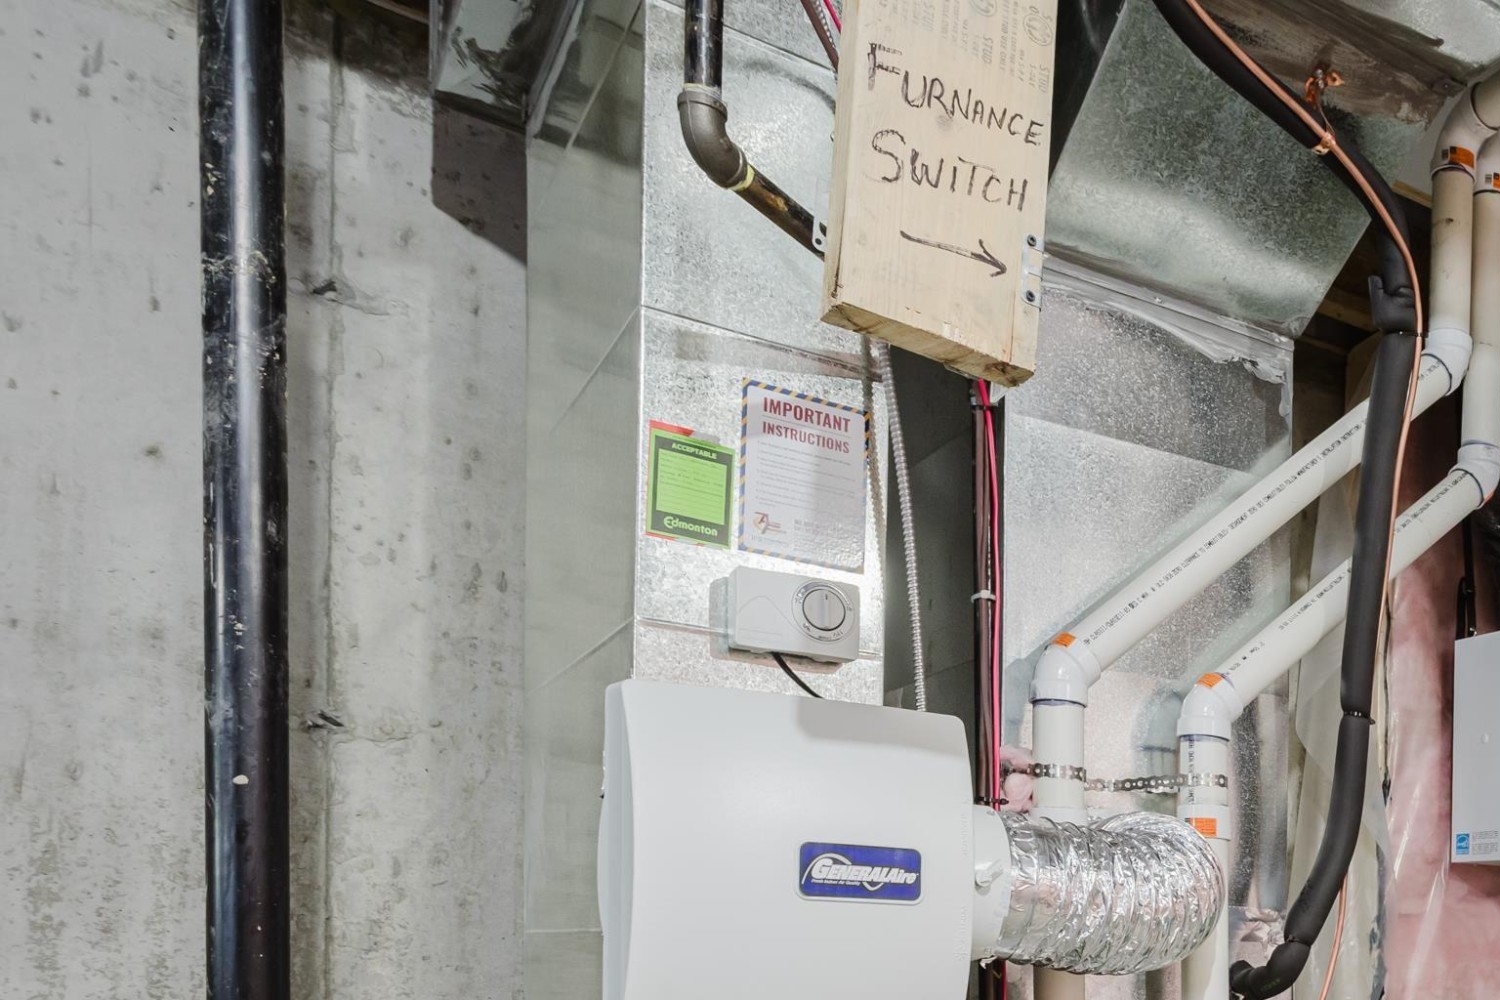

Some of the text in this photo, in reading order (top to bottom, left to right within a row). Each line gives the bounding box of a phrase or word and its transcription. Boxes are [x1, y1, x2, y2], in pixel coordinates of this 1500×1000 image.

[867, 42, 1044, 146] FURNANCE
[871, 129, 1028, 211] SWITCH
[763, 396, 850, 433] IMPORTANT
[671, 441, 717, 460] ACCEPTABLE
[762, 420, 850, 454] INSTRUCTIONS
[663, 516, 718, 537] Edmonton
